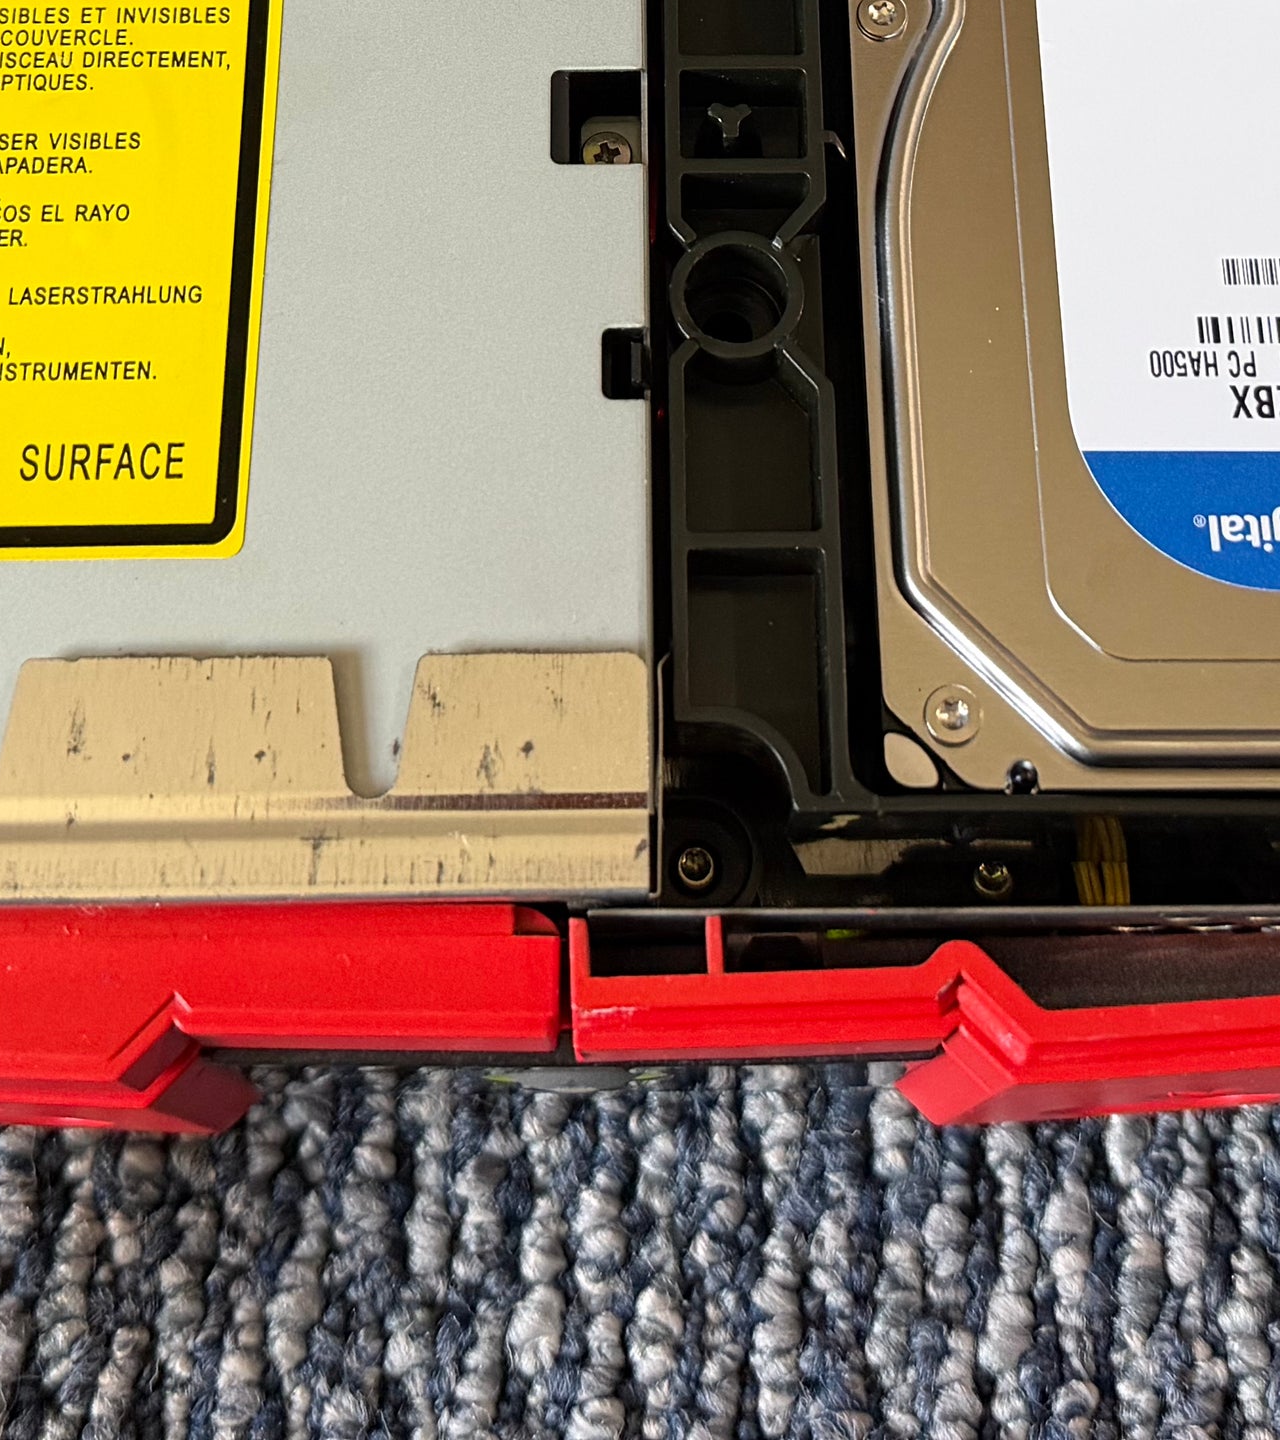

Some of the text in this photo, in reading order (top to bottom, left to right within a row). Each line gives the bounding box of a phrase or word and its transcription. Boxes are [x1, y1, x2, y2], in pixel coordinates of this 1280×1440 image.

[81, 8, 106, 23] ET
[117, 7, 230, 23] INVISIBLES
[83, 51, 229, 70] DIRECTEMENT,
[50, 132, 140, 150] VISIBLES
[41, 205, 63, 222] EL
[75, 204, 129, 221] RAYO
[9, 286, 201, 305] LASERSTRAHLUNG
[1150, 351, 1218, 377] HA500
[1228, 351, 1256, 378] PC
[20, 443, 184, 481] SURFACE
